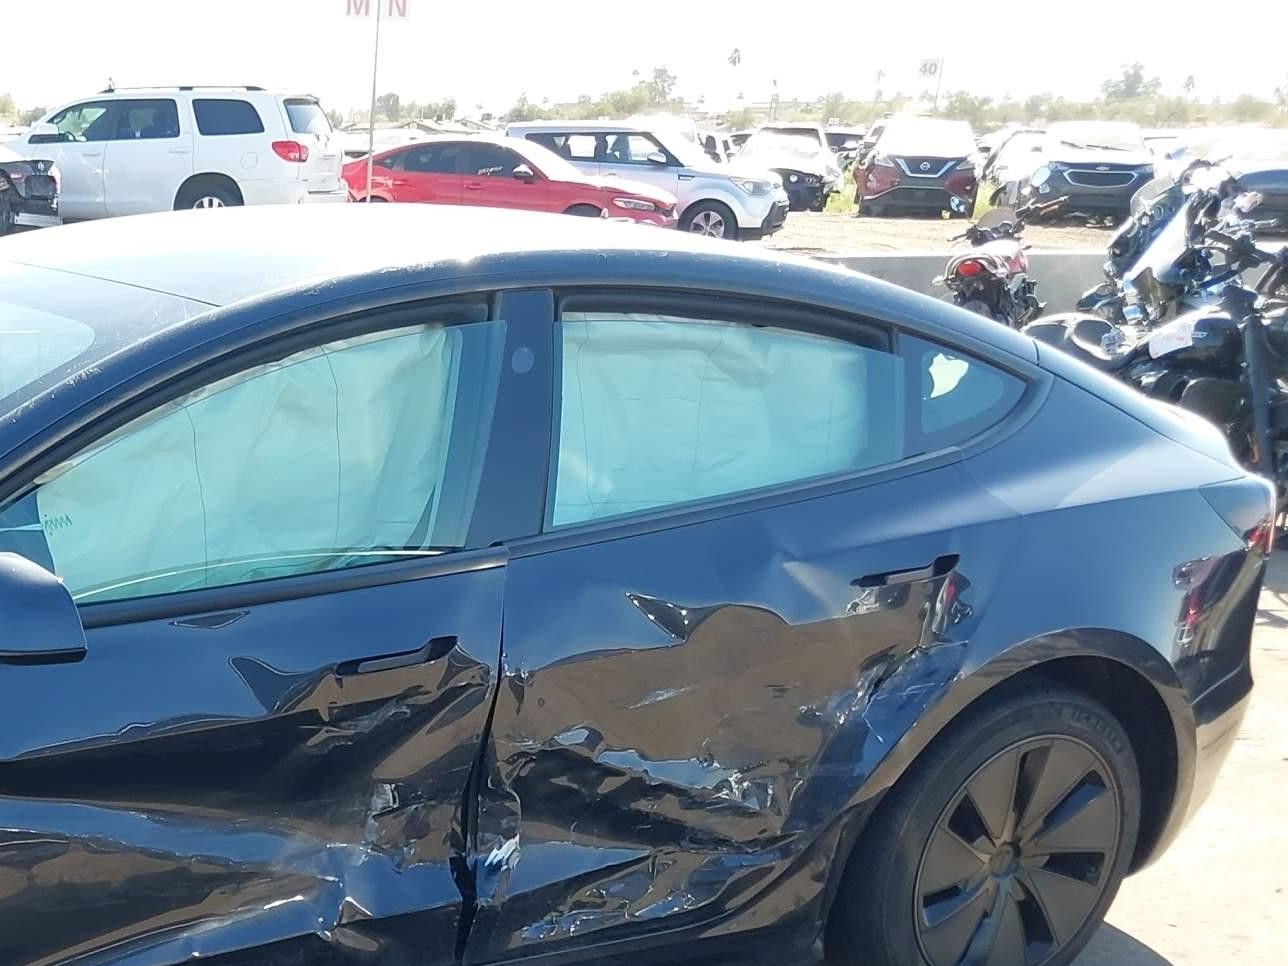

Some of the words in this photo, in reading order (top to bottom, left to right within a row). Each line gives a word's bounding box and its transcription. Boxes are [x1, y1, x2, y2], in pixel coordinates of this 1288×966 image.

[346, 0, 370, 16] M
[388, 0, 407, 17] N
[920, 62, 937, 76] 40
